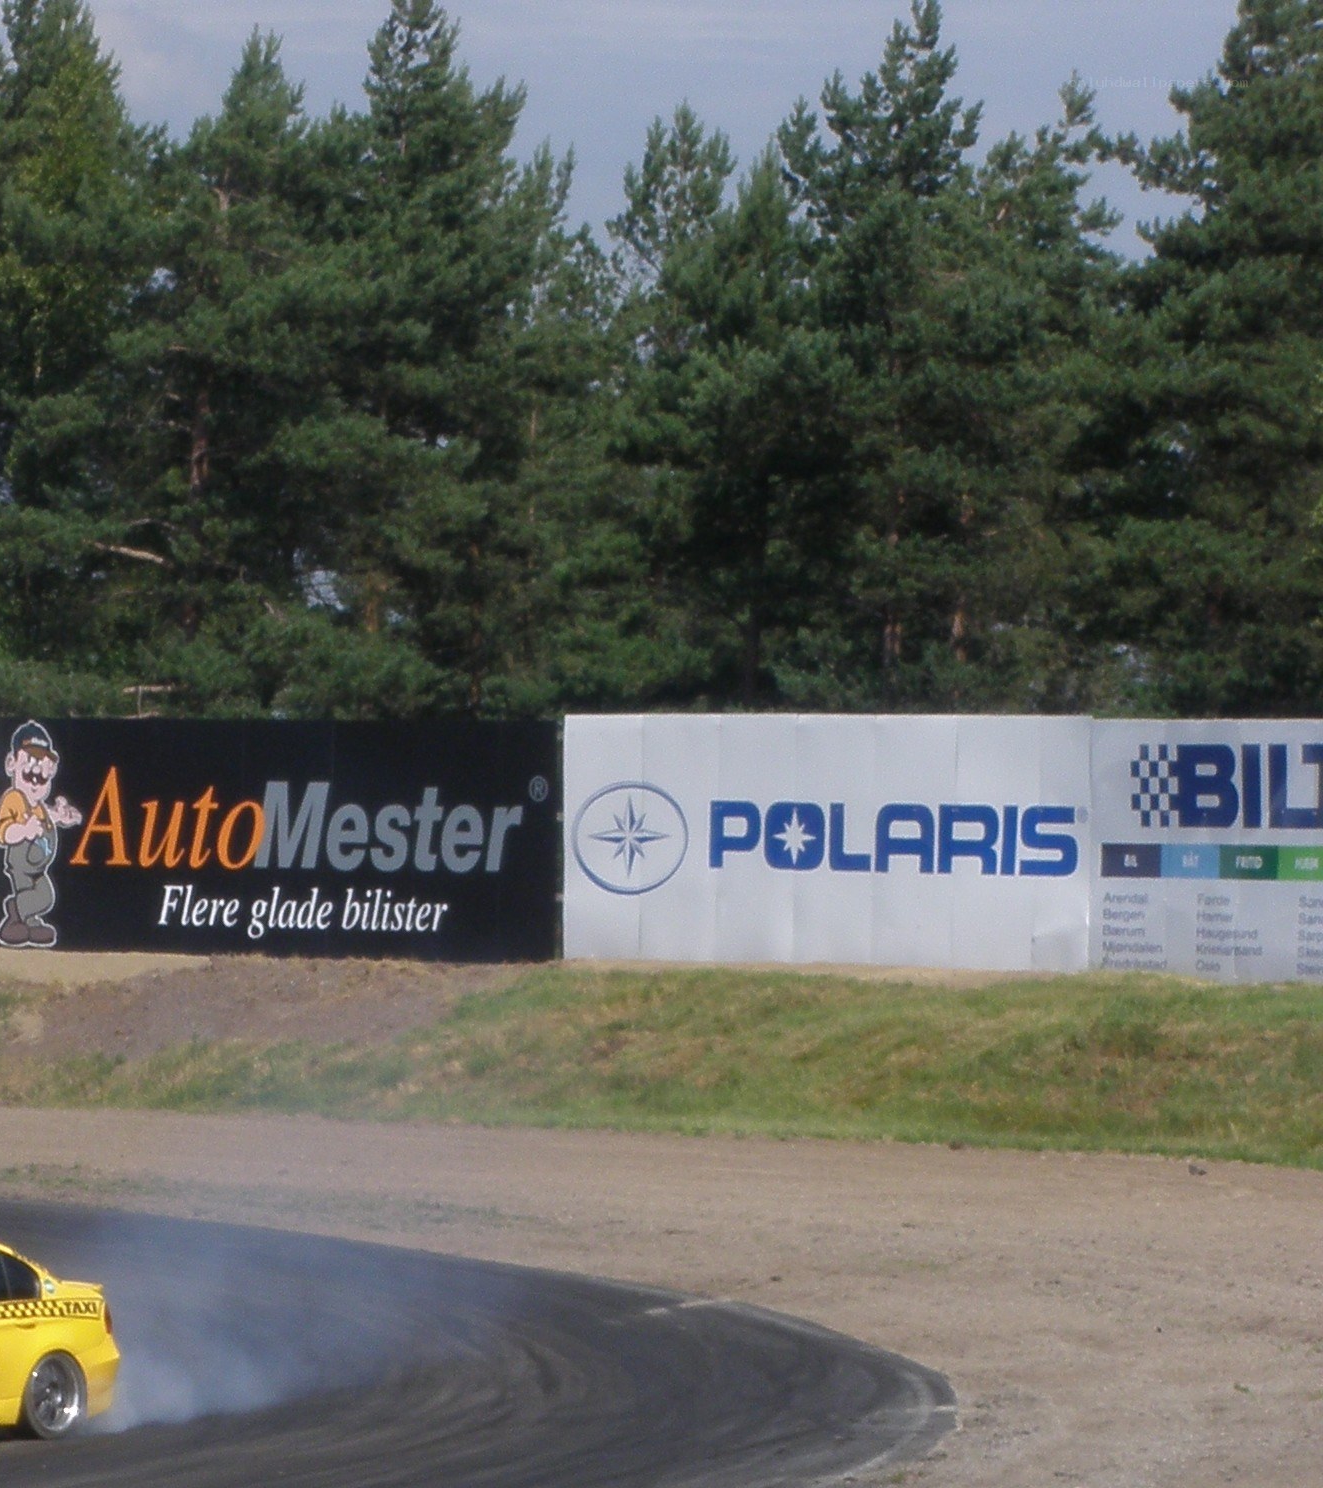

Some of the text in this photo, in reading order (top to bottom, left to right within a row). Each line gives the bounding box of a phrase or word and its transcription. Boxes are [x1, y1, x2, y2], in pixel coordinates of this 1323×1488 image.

[70, 766, 525, 874] AutoMester
[709, 800, 1078, 876] POLARIS
[158, 884, 448, 939] Flere glade bilister
[65, 1301, 99, 1314] TAXI
